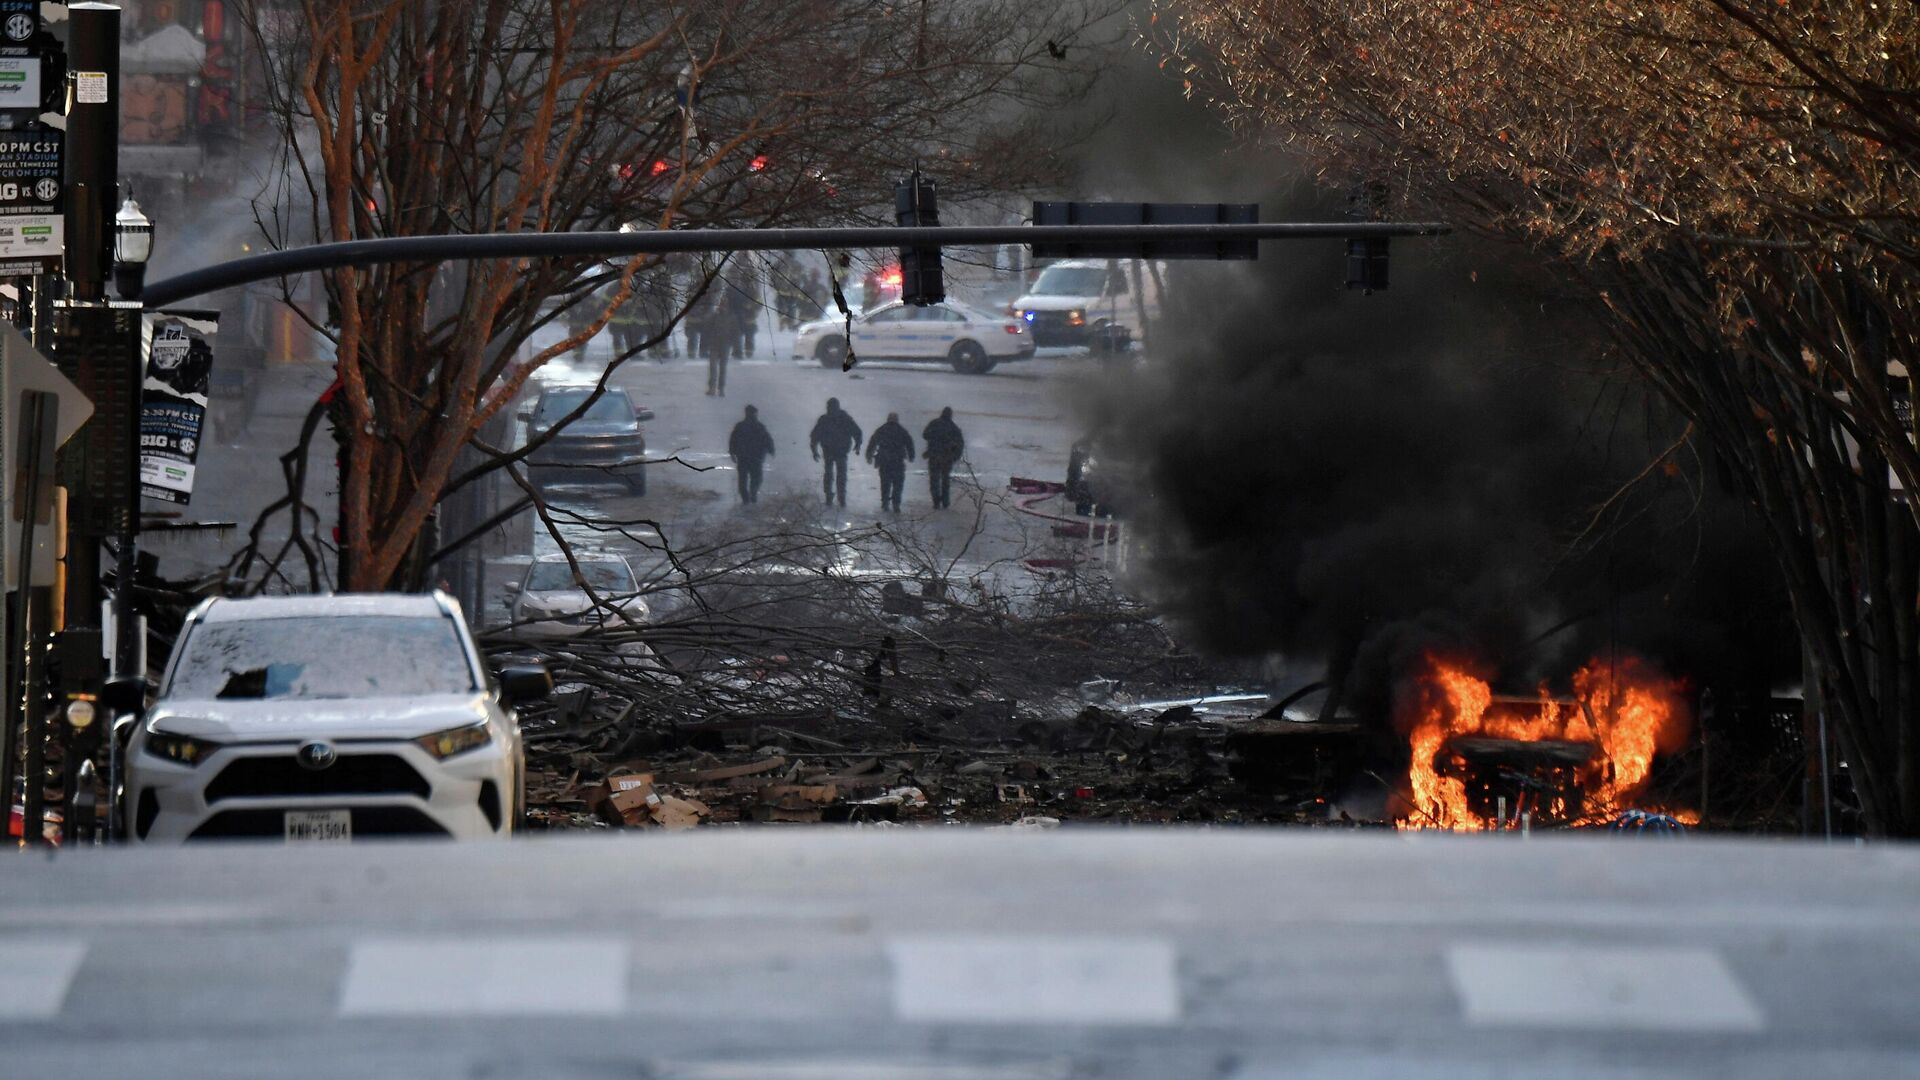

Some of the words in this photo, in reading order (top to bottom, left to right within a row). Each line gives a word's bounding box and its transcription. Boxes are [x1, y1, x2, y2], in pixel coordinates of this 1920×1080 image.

[2, 2, 33, 11] ESPN
[8, 15, 31, 39] SEC
[10, 142, 30, 153] PM
[33, 142, 59, 153] CST
[16, 153, 59, 161] STADIUM
[16, 169, 31, 177] ON
[33, 169, 58, 177] ESPN
[37, 179, 57, 200] SEC
[166, 409, 180, 419] PM
[182, 411, 201, 423] CST
